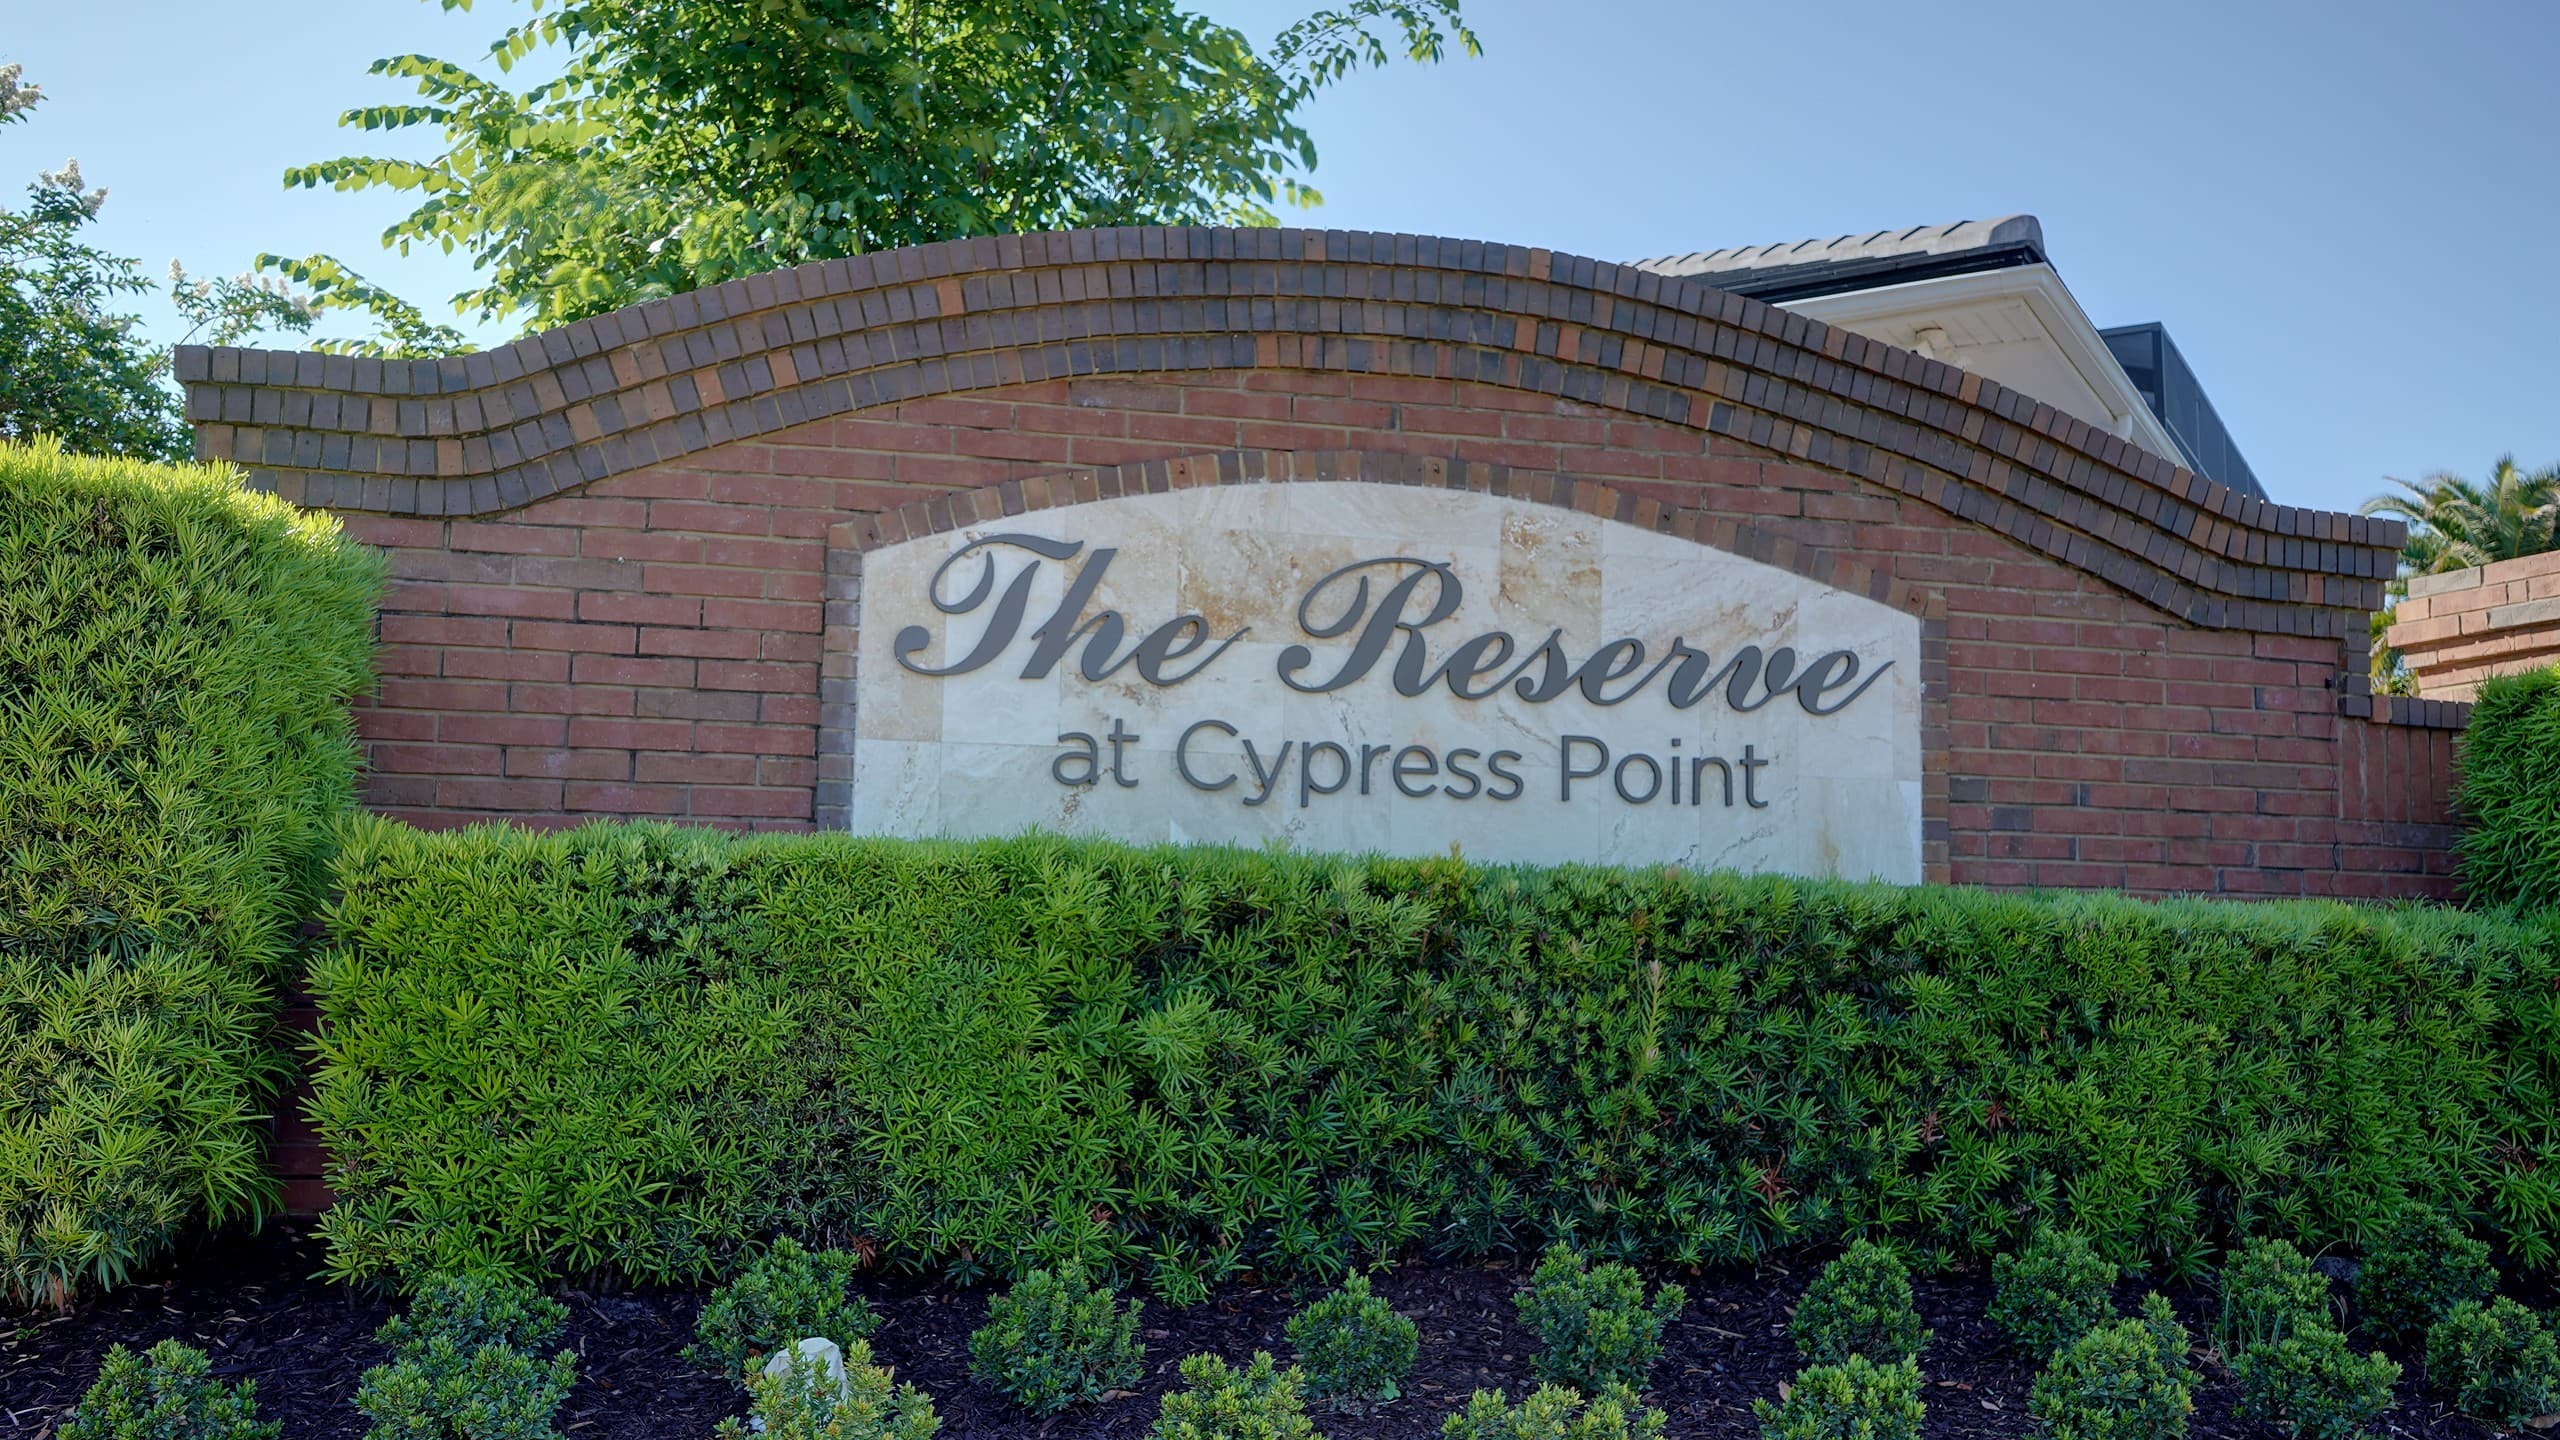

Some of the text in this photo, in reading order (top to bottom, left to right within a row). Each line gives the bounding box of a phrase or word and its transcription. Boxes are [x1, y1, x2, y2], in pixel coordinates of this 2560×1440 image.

[894, 532, 1896, 716] The Reserve
[1051, 718, 1769, 809] at Cypress Point
